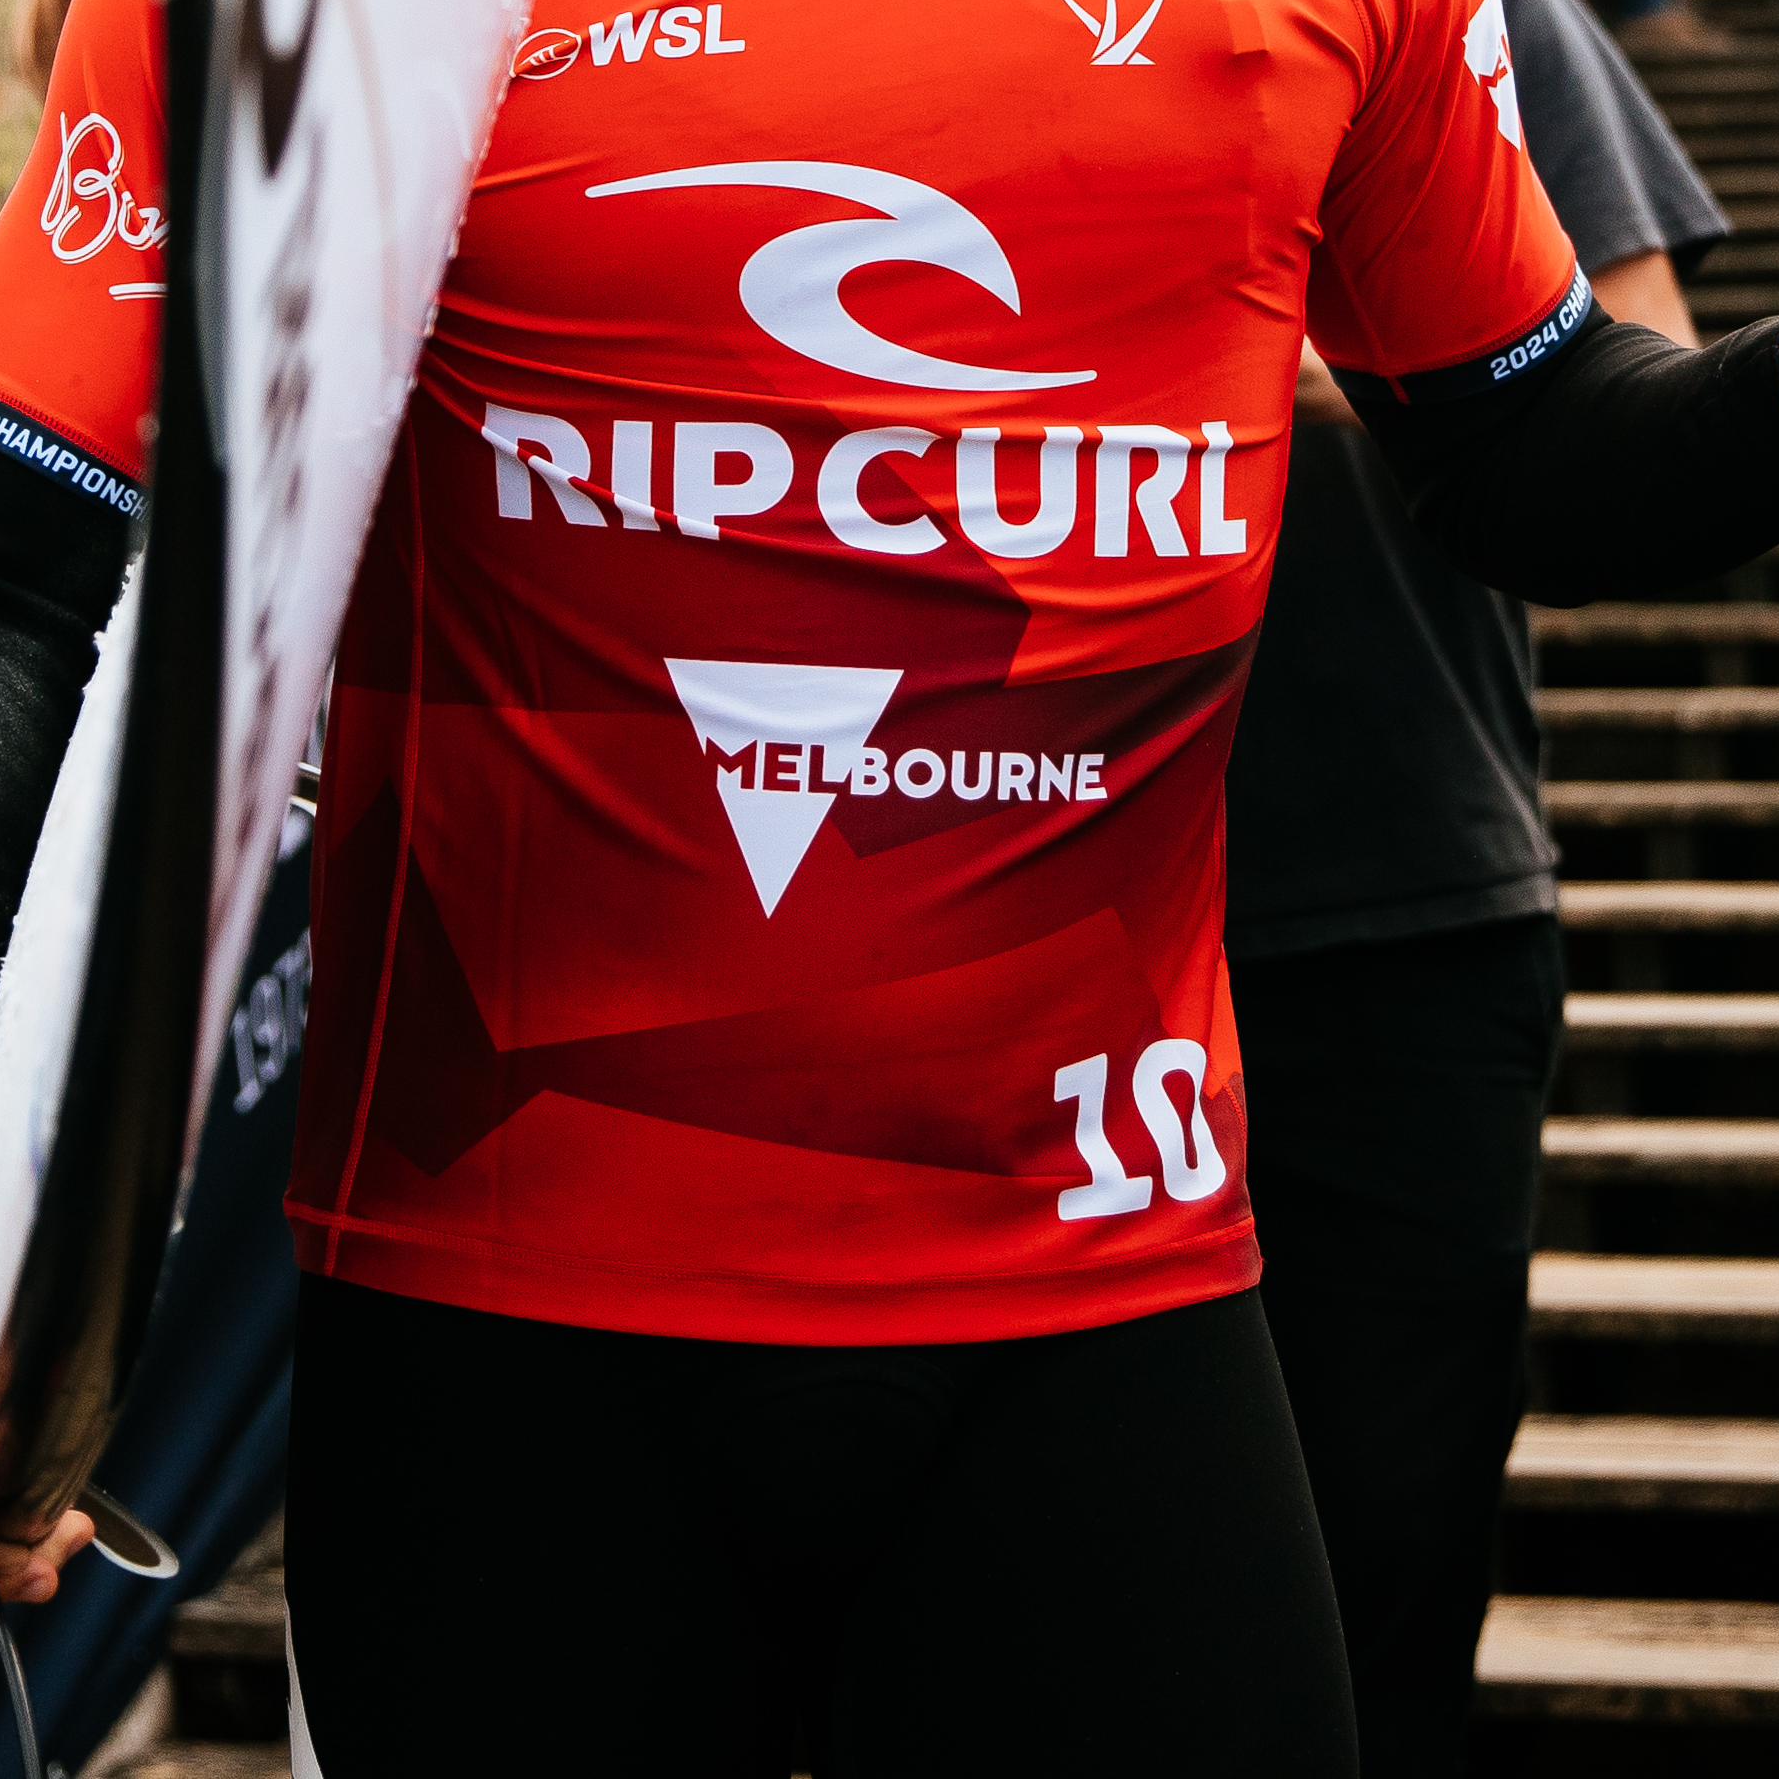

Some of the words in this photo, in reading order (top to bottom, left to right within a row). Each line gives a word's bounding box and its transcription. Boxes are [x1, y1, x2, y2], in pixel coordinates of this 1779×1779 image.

[588, 3, 746, 67] WSL
[1490, 320, 1560, 380] 2024
[703, 735, 1109, 802] MELBOURNE
[1053, 1037, 1227, 1222] 10
